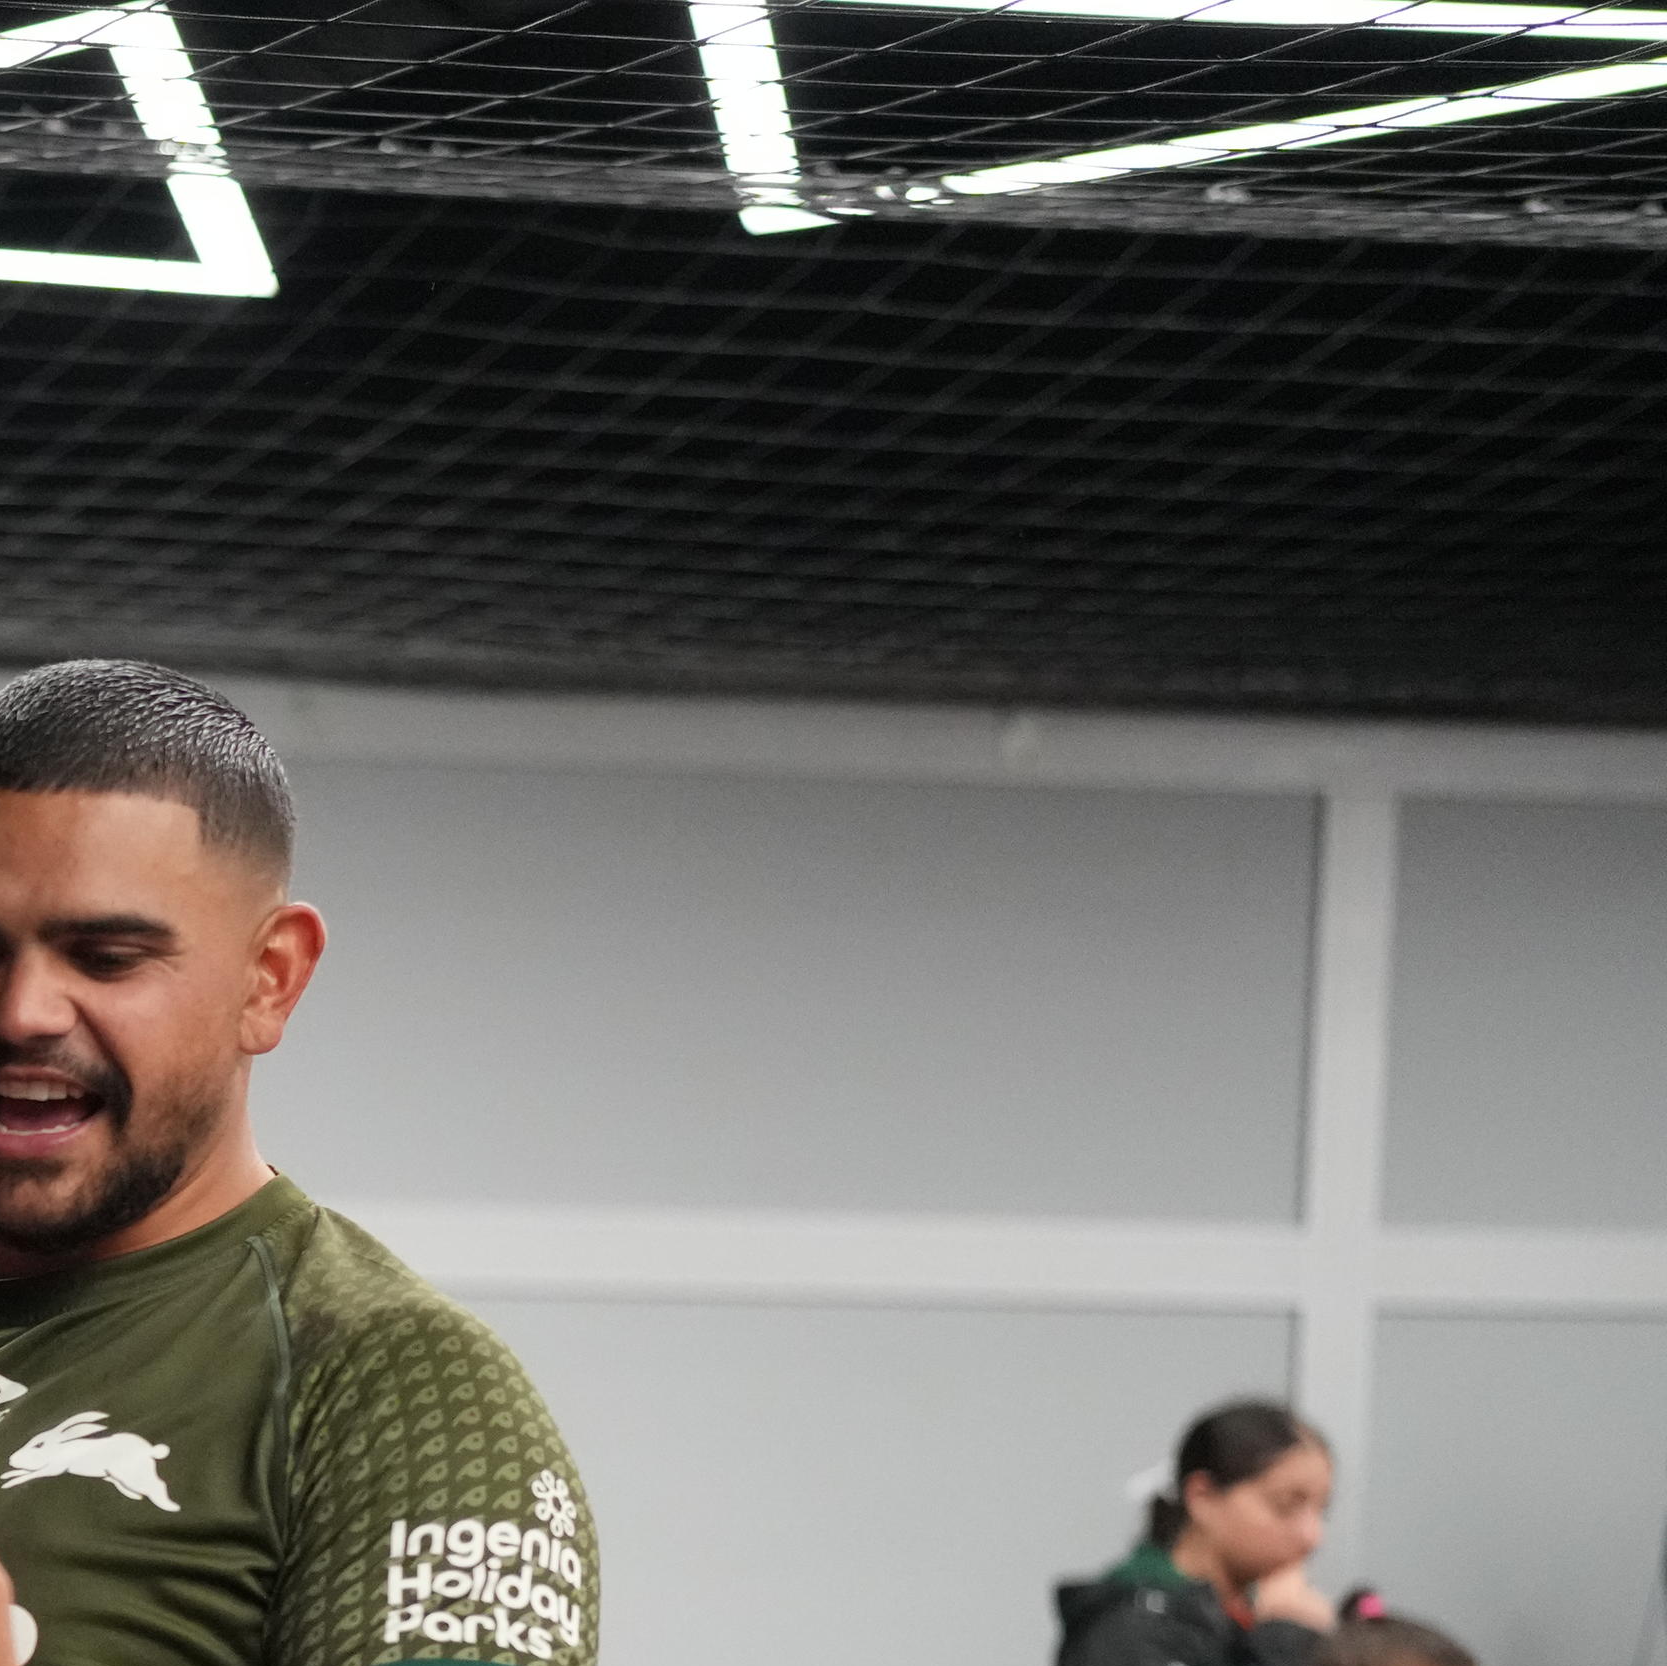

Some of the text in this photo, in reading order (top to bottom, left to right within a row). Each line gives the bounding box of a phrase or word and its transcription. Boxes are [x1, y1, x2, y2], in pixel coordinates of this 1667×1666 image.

[390, 1519, 581, 1589] Ingenia
[384, 1603, 553, 1660] Parks
[387, 1556, 580, 1647] Holiday
